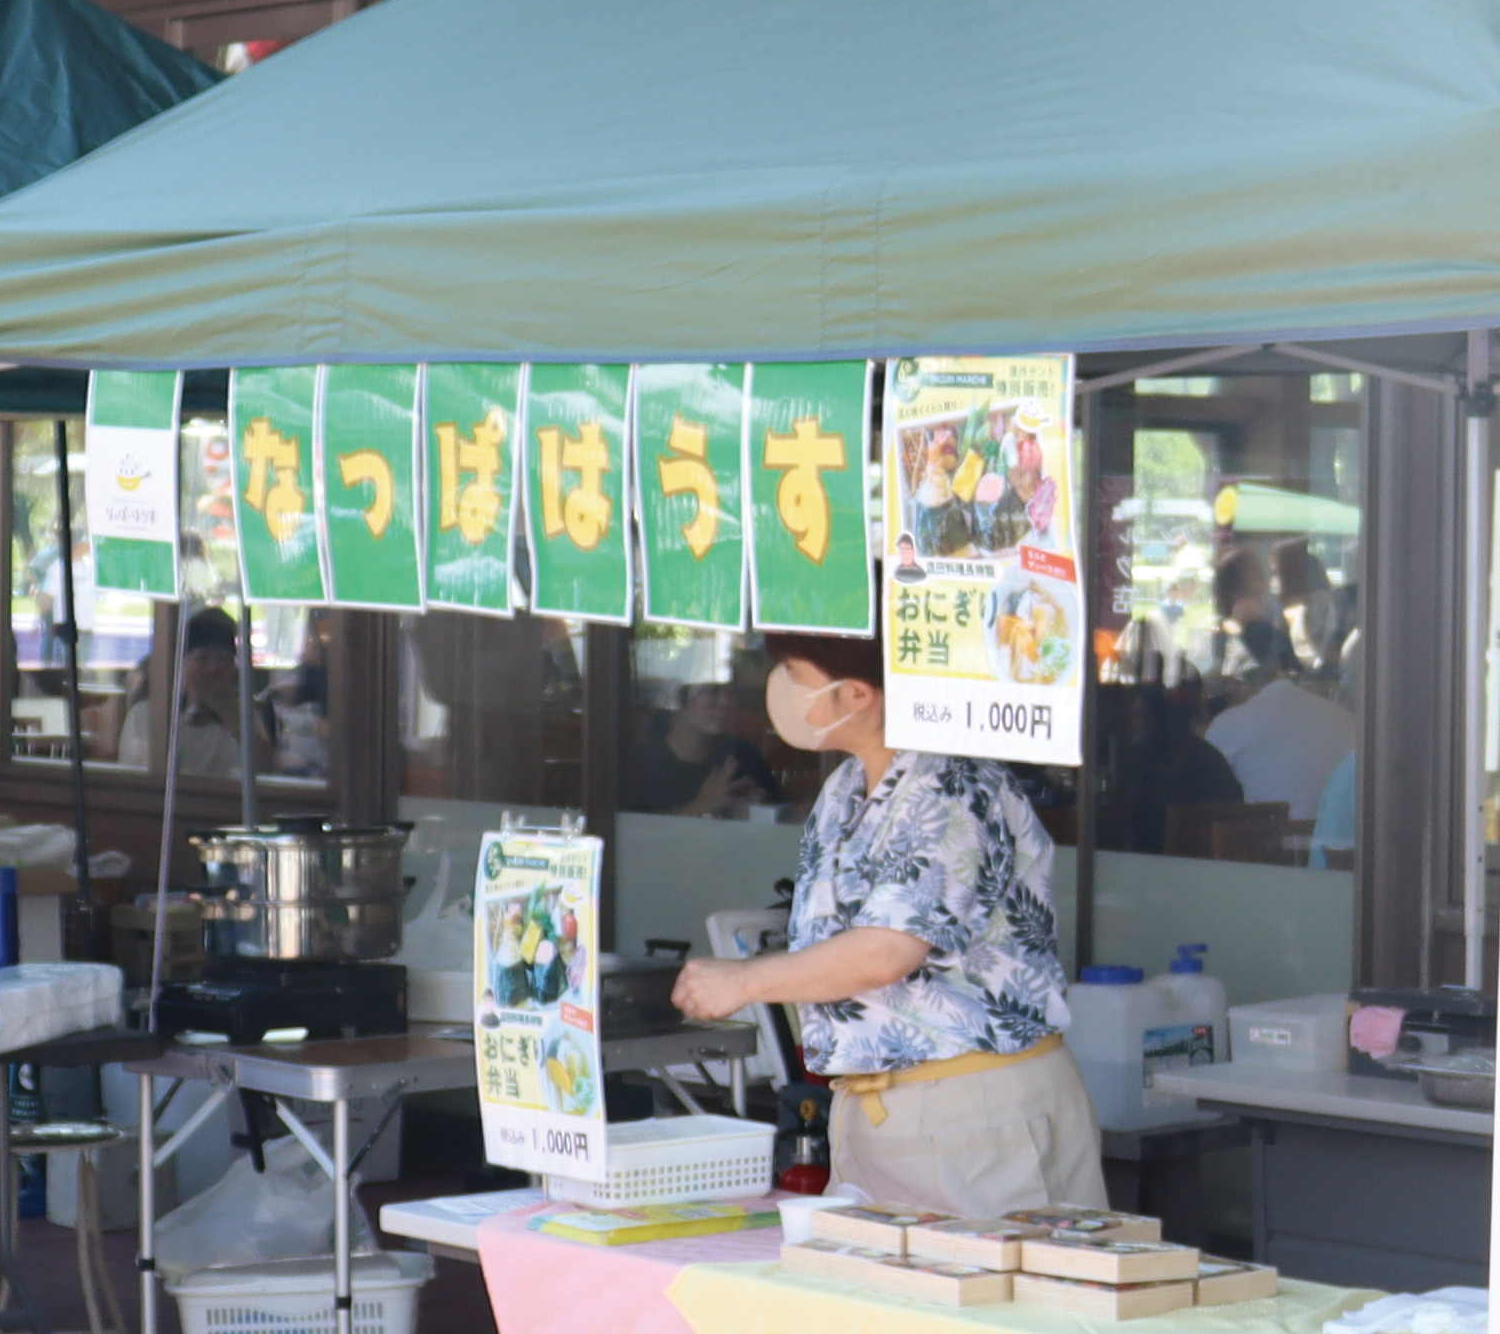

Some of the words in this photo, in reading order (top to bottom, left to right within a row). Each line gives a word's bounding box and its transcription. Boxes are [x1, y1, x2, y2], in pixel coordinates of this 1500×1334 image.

[896, 587, 998, 629] おにぎり
[897, 628, 951, 667] 弁当
[913, 702, 952, 723] 税込み
[484, 1033, 546, 1070] おにぎり
[486, 1068, 521, 1099] 弁当
